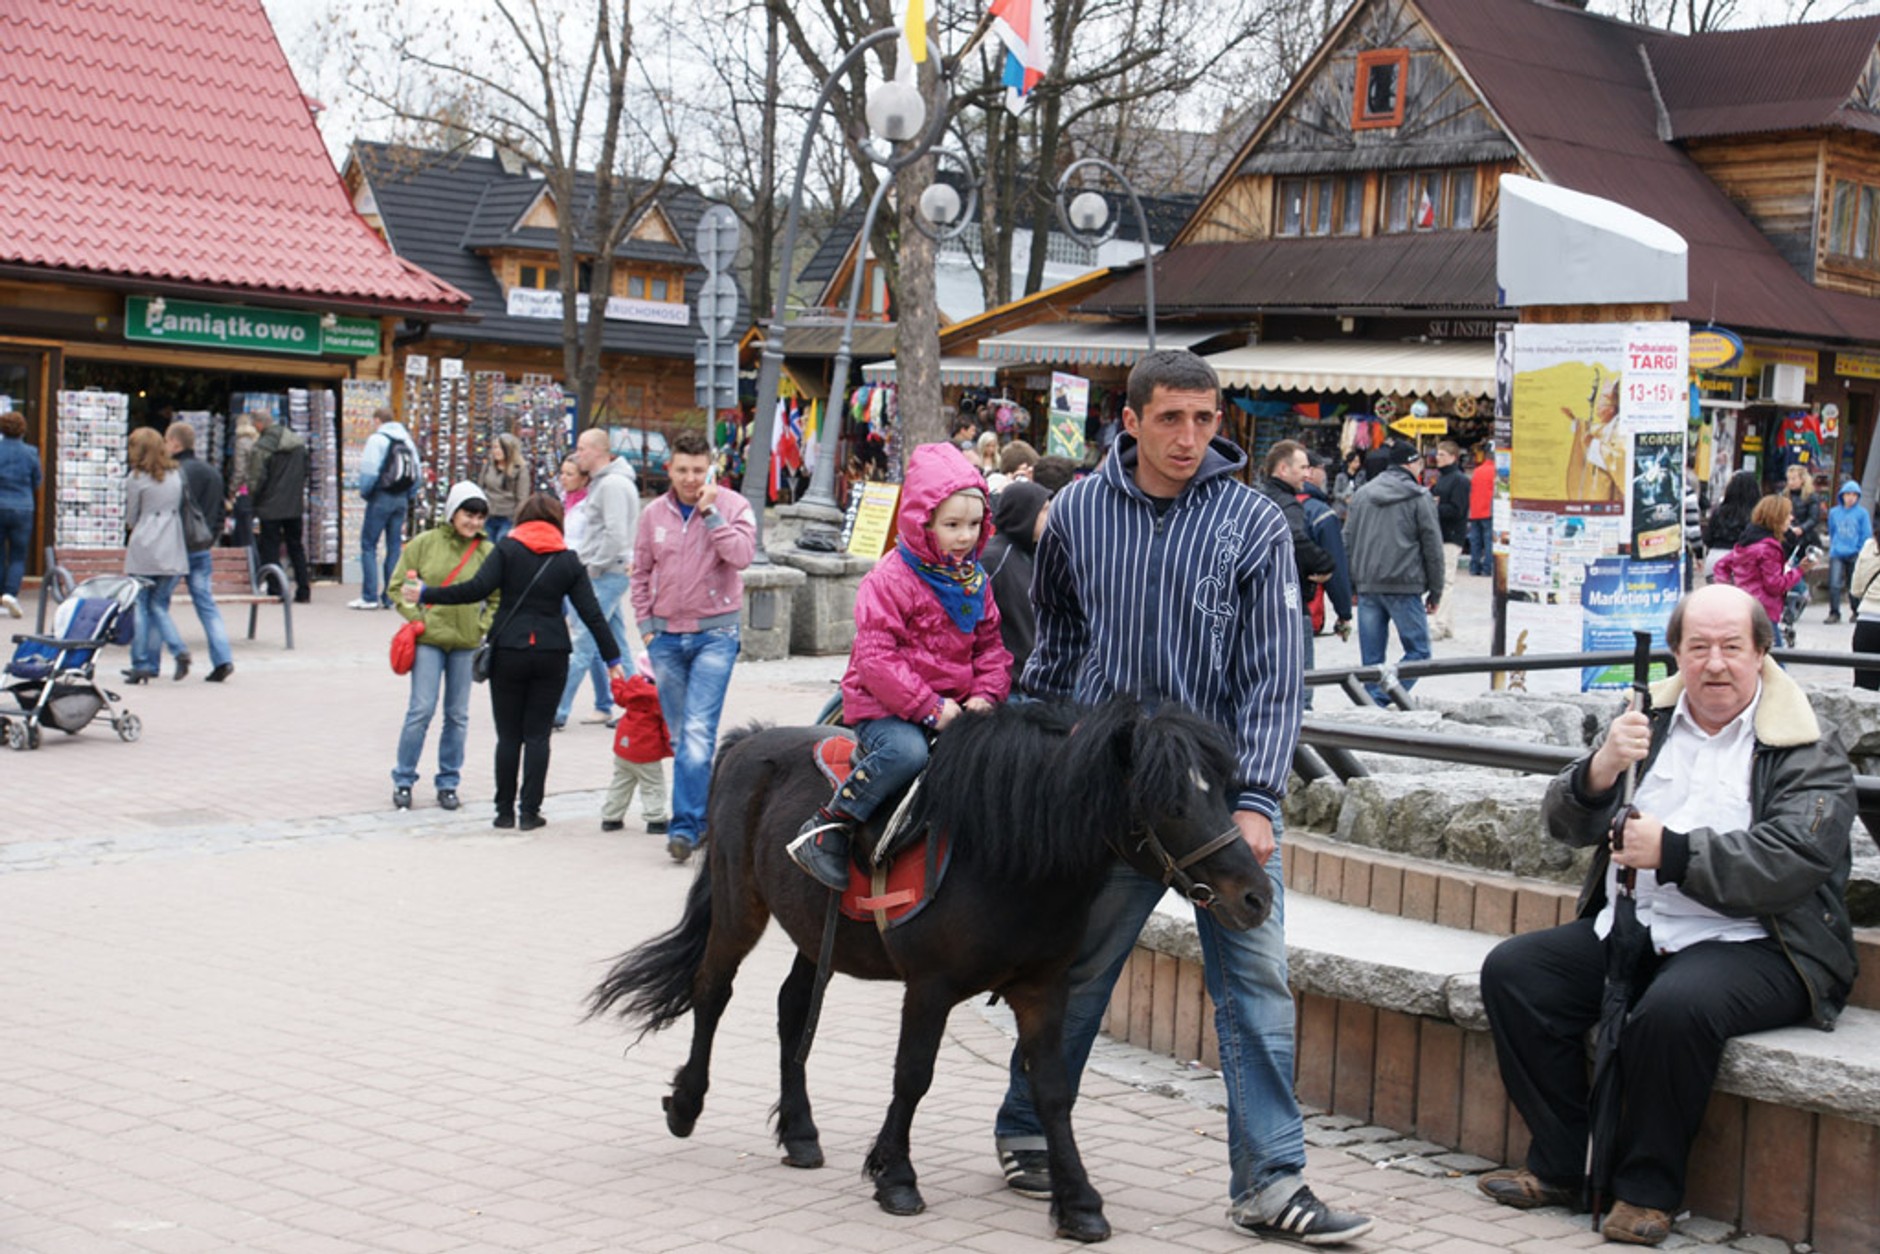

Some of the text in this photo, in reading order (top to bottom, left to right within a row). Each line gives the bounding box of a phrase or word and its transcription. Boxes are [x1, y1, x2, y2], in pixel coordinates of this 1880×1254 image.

[146, 305, 305, 342] Pamiątkowo
[1429, 321, 1450, 337] SKI
[1629, 354, 1678, 369] TARGI
[1589, 590, 1650, 608] Marketing
[1652, 593, 1660, 603] w
